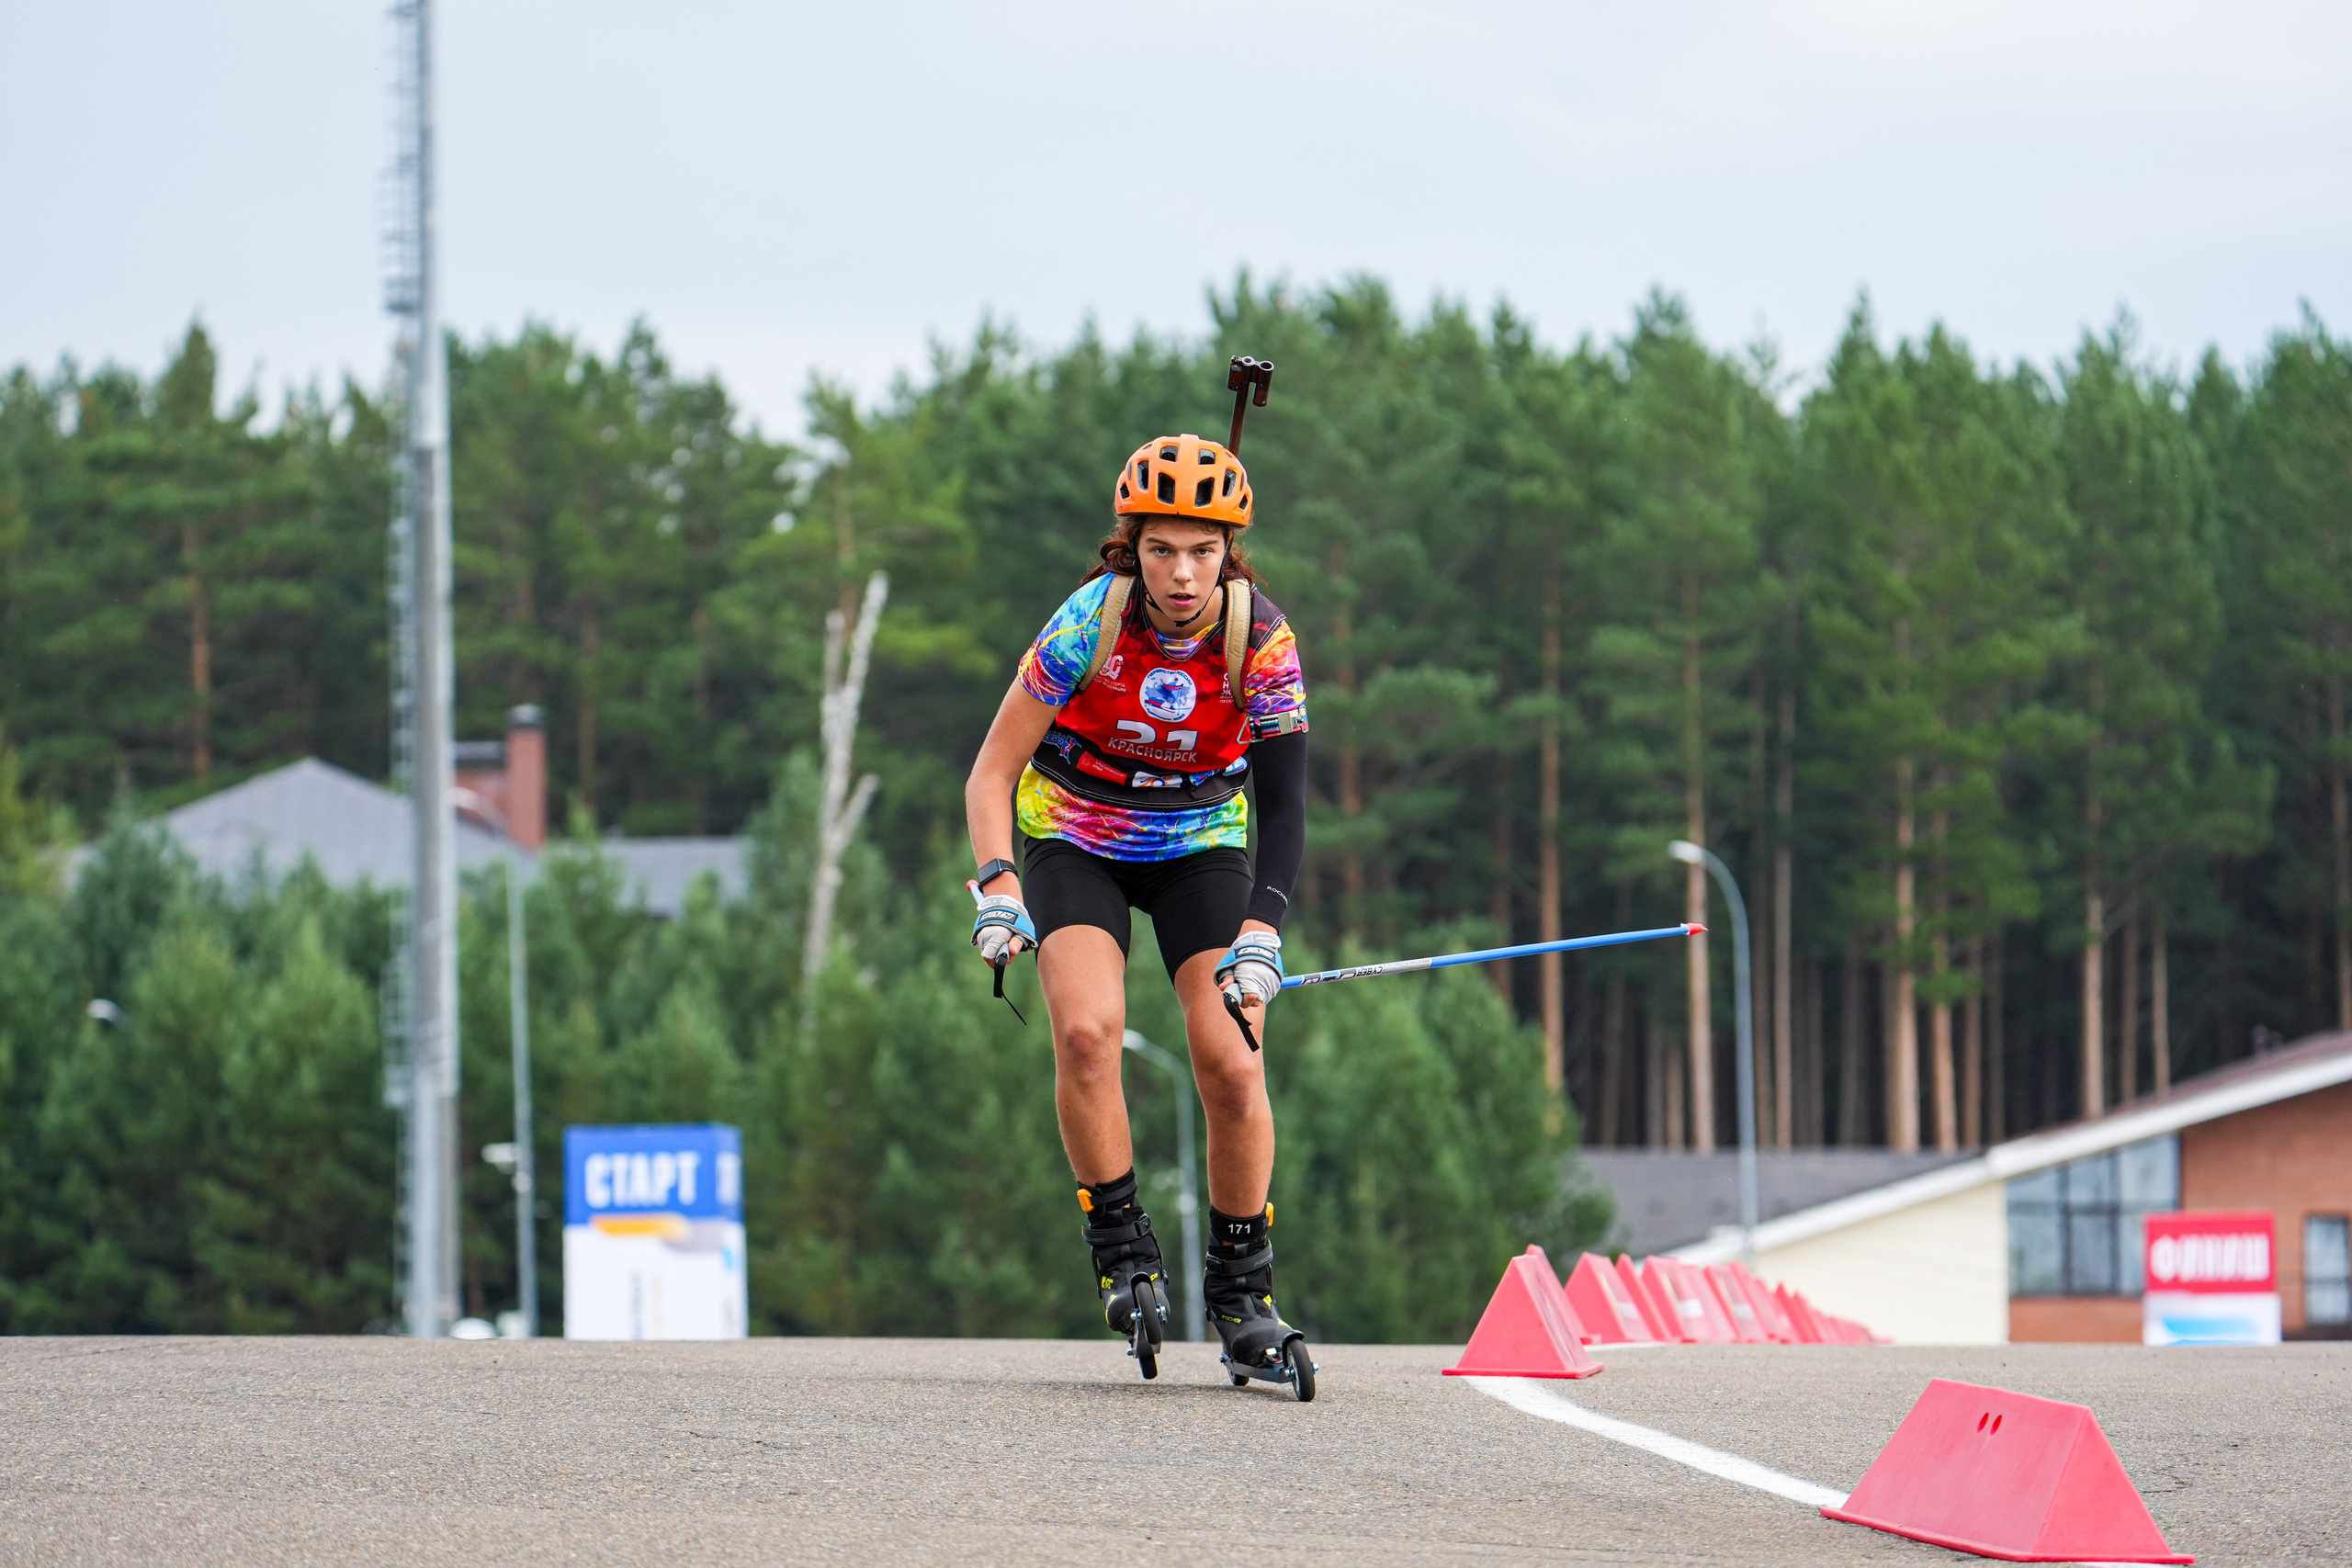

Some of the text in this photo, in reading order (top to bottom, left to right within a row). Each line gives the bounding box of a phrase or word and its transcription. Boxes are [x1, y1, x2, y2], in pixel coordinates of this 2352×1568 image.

[1108, 737, 1197, 763] КРАСНОЯРСК
[1357, 966, 1383, 976] CYBER
[585, 1151, 700, 1209] СТАРТ
[1227, 1224, 1251, 1235] 171
[2150, 1233, 2270, 1282] ФИНИШ
